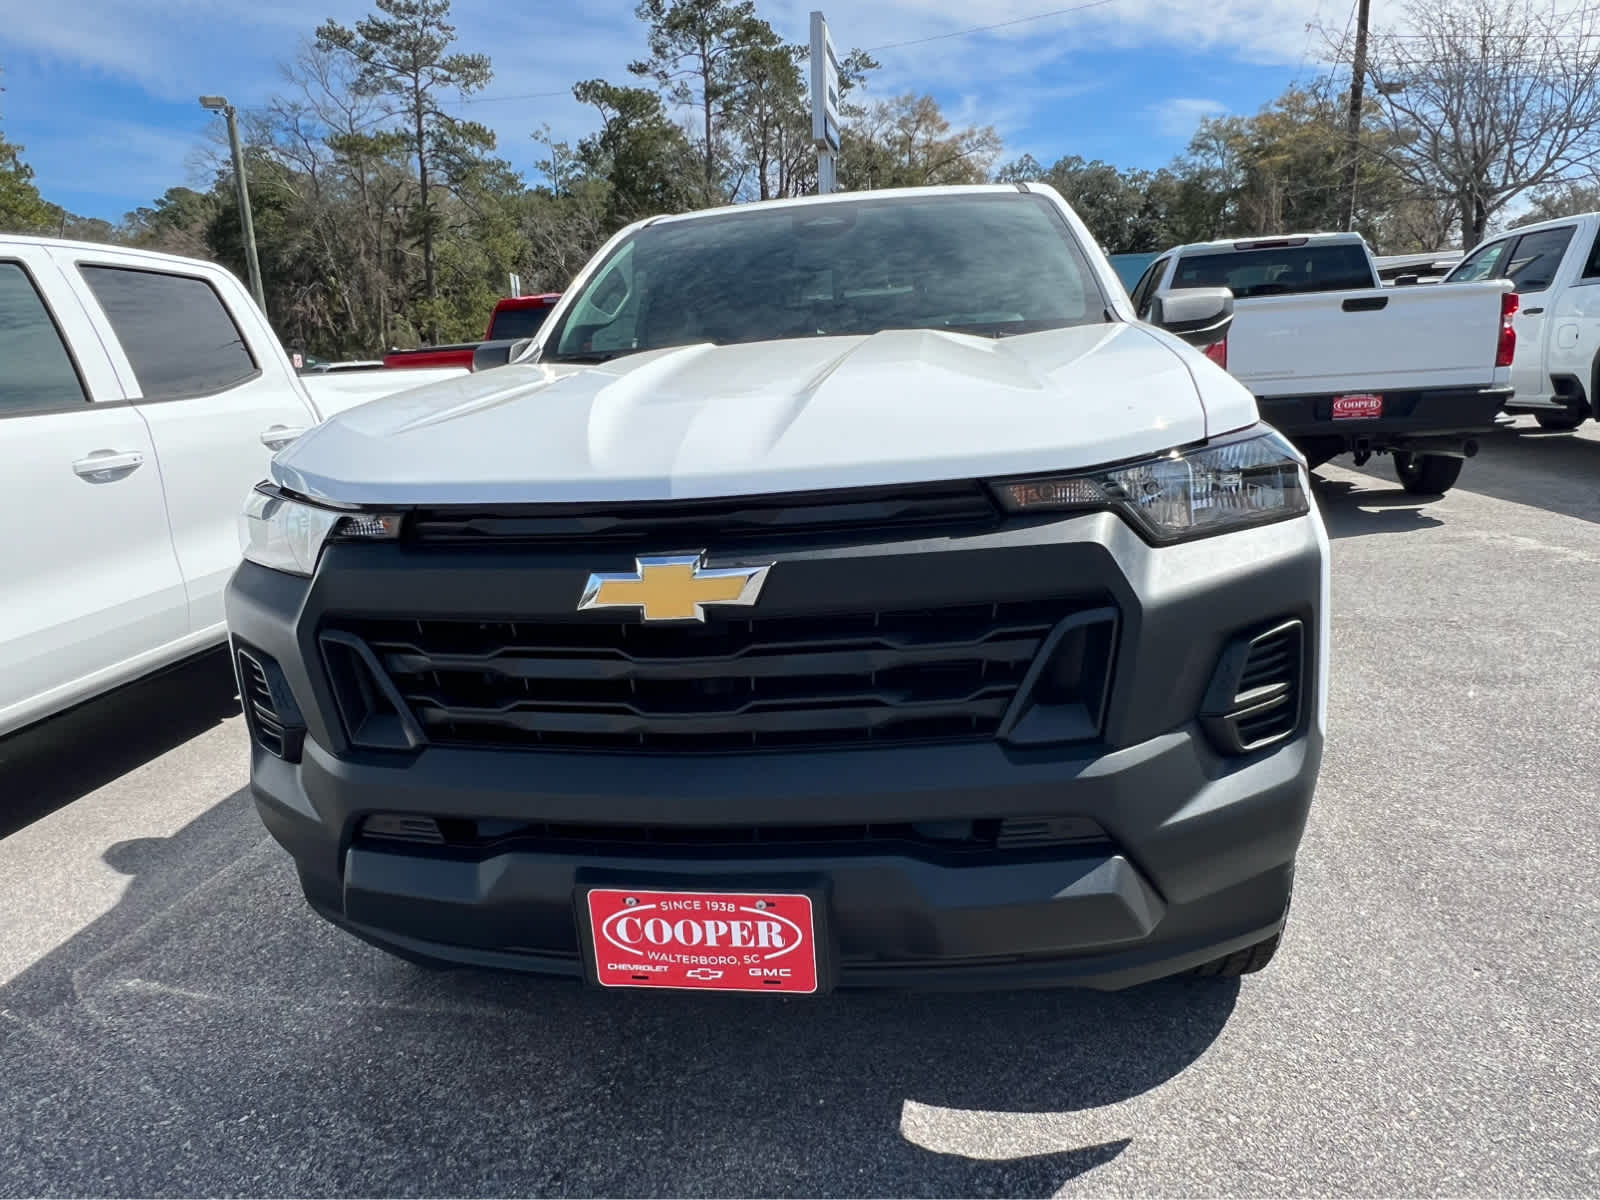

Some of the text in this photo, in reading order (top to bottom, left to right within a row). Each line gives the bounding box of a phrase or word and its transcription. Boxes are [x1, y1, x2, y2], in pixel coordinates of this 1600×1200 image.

[1337, 400, 1377, 409] COOPER
[660, 900, 736, 913] SINCE 1938
[616, 917, 786, 948] COOPER
[647, 951, 761, 966] WALTERBORO, SC
[607, 963, 669, 973] CHEVROLET
[748, 968, 791, 977] GMC
